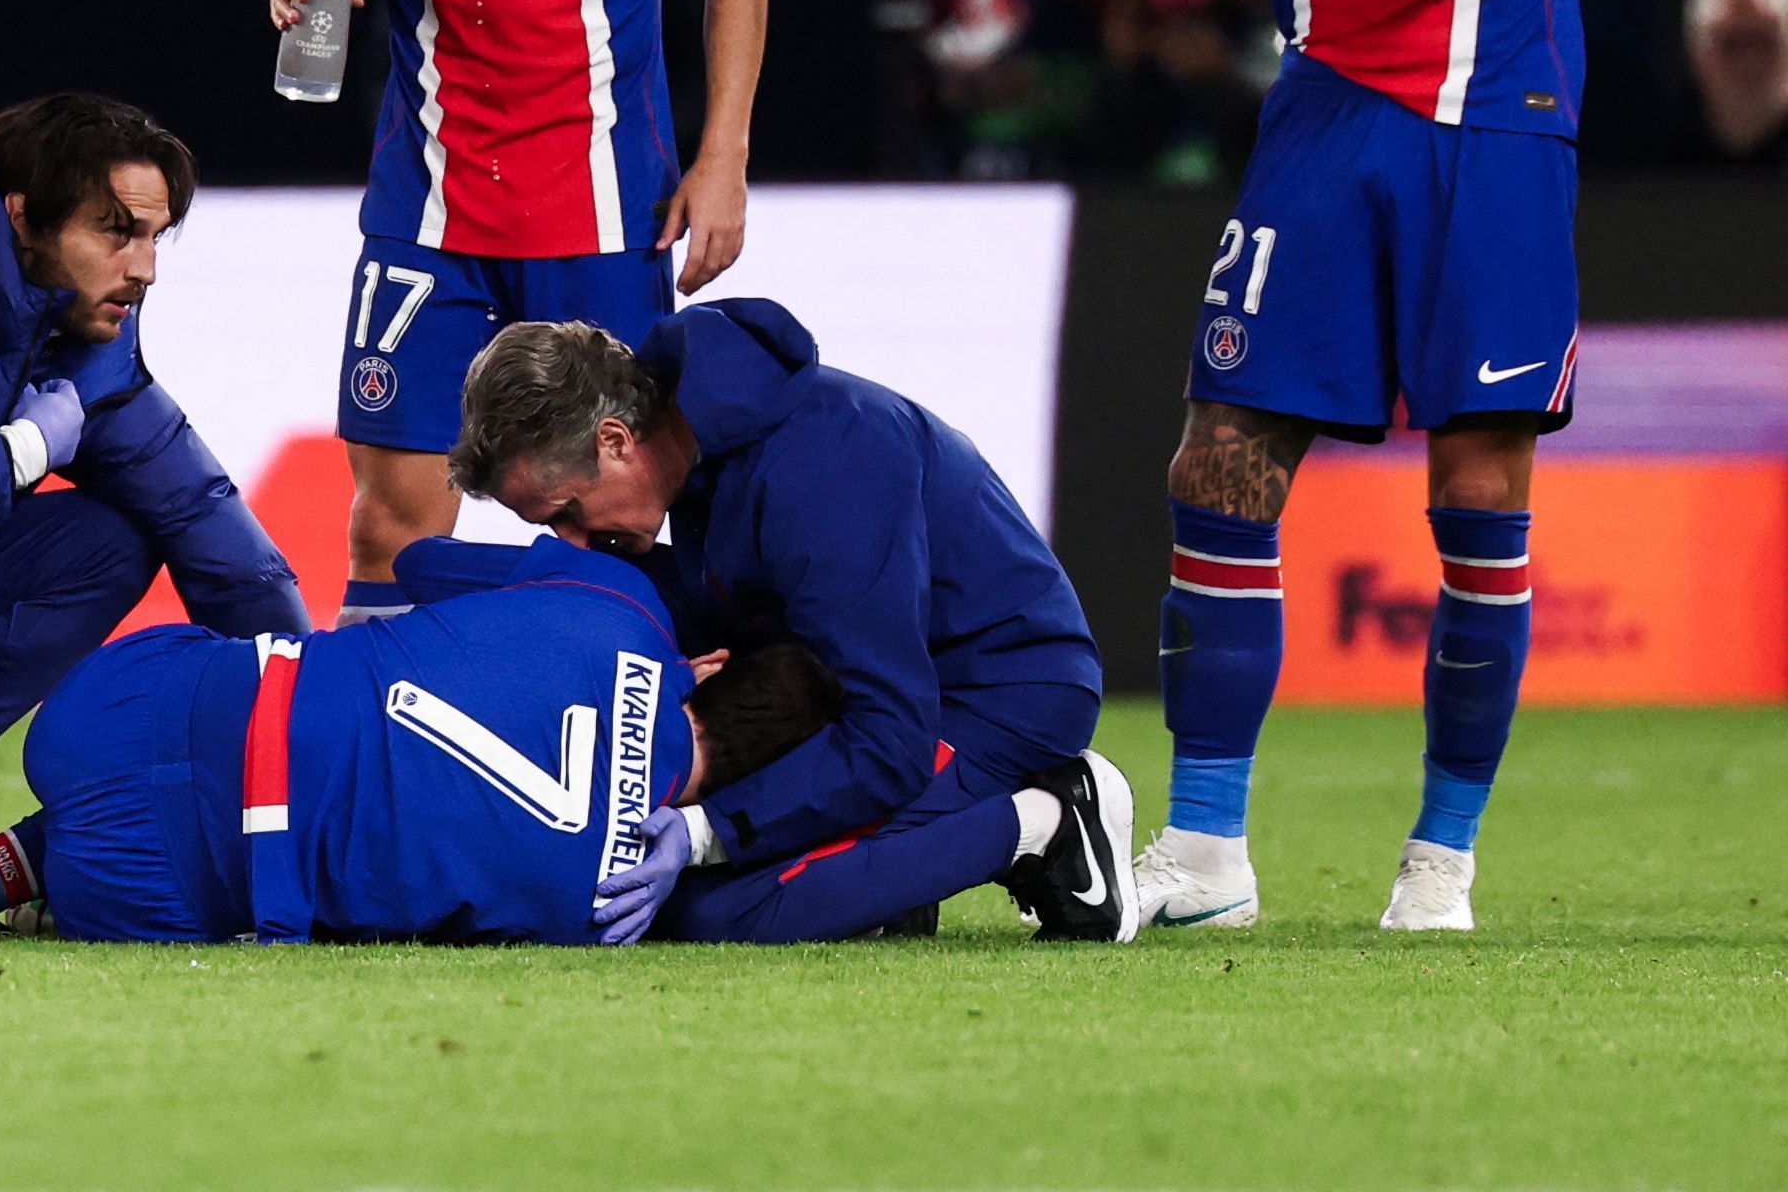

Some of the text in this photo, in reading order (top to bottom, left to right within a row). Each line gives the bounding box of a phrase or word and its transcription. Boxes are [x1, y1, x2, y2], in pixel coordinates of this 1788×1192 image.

[354, 260, 435, 353] 17
[1204, 218, 1276, 315] 21
[359, 359, 389, 373] PARIS
[1213, 319, 1242, 334] PARIS
[386, 680, 598, 834] 7
